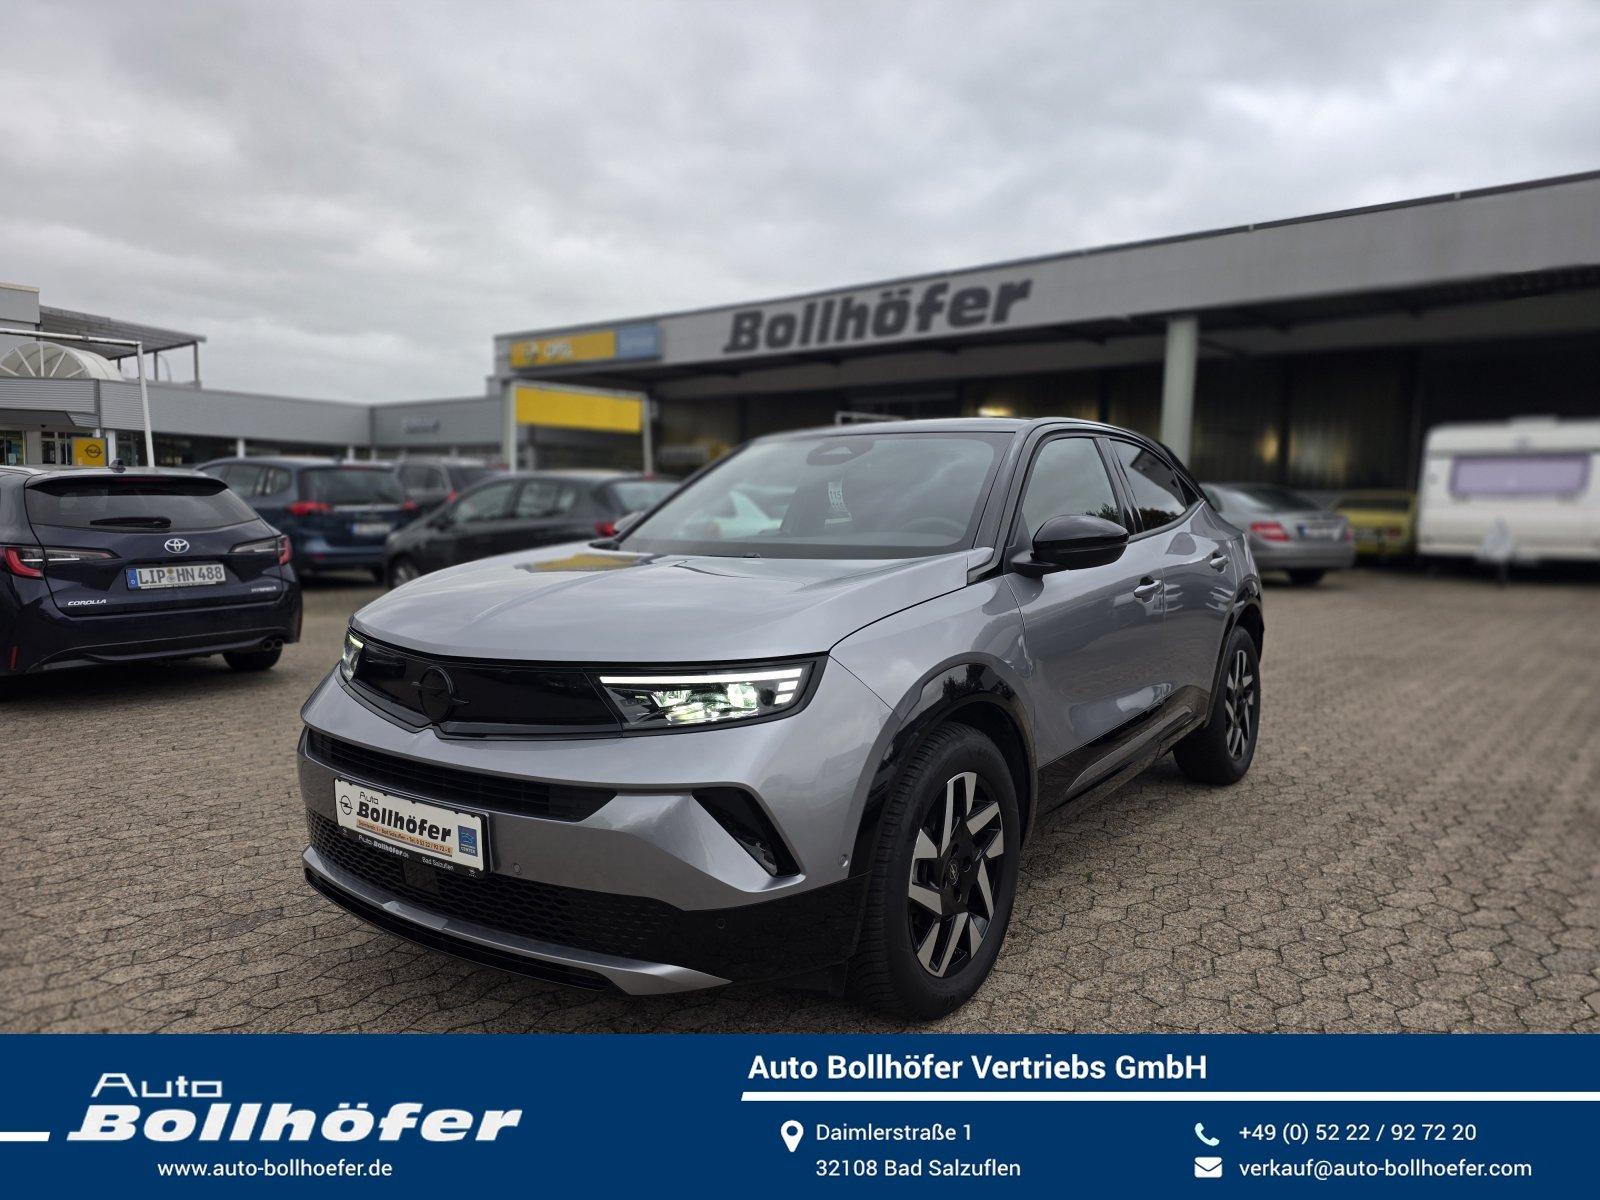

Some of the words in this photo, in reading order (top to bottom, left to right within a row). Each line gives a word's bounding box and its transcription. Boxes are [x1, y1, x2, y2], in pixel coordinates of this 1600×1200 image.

[725, 279, 1033, 354] Bollhöfer
[138, 569, 166, 585] LIP
[176, 567, 195, 582] HN
[198, 566, 223, 581] 488
[67, 598, 107, 606] COROLLA
[359, 791, 379, 805] Auto
[356, 801, 452, 843] Bollhöfer
